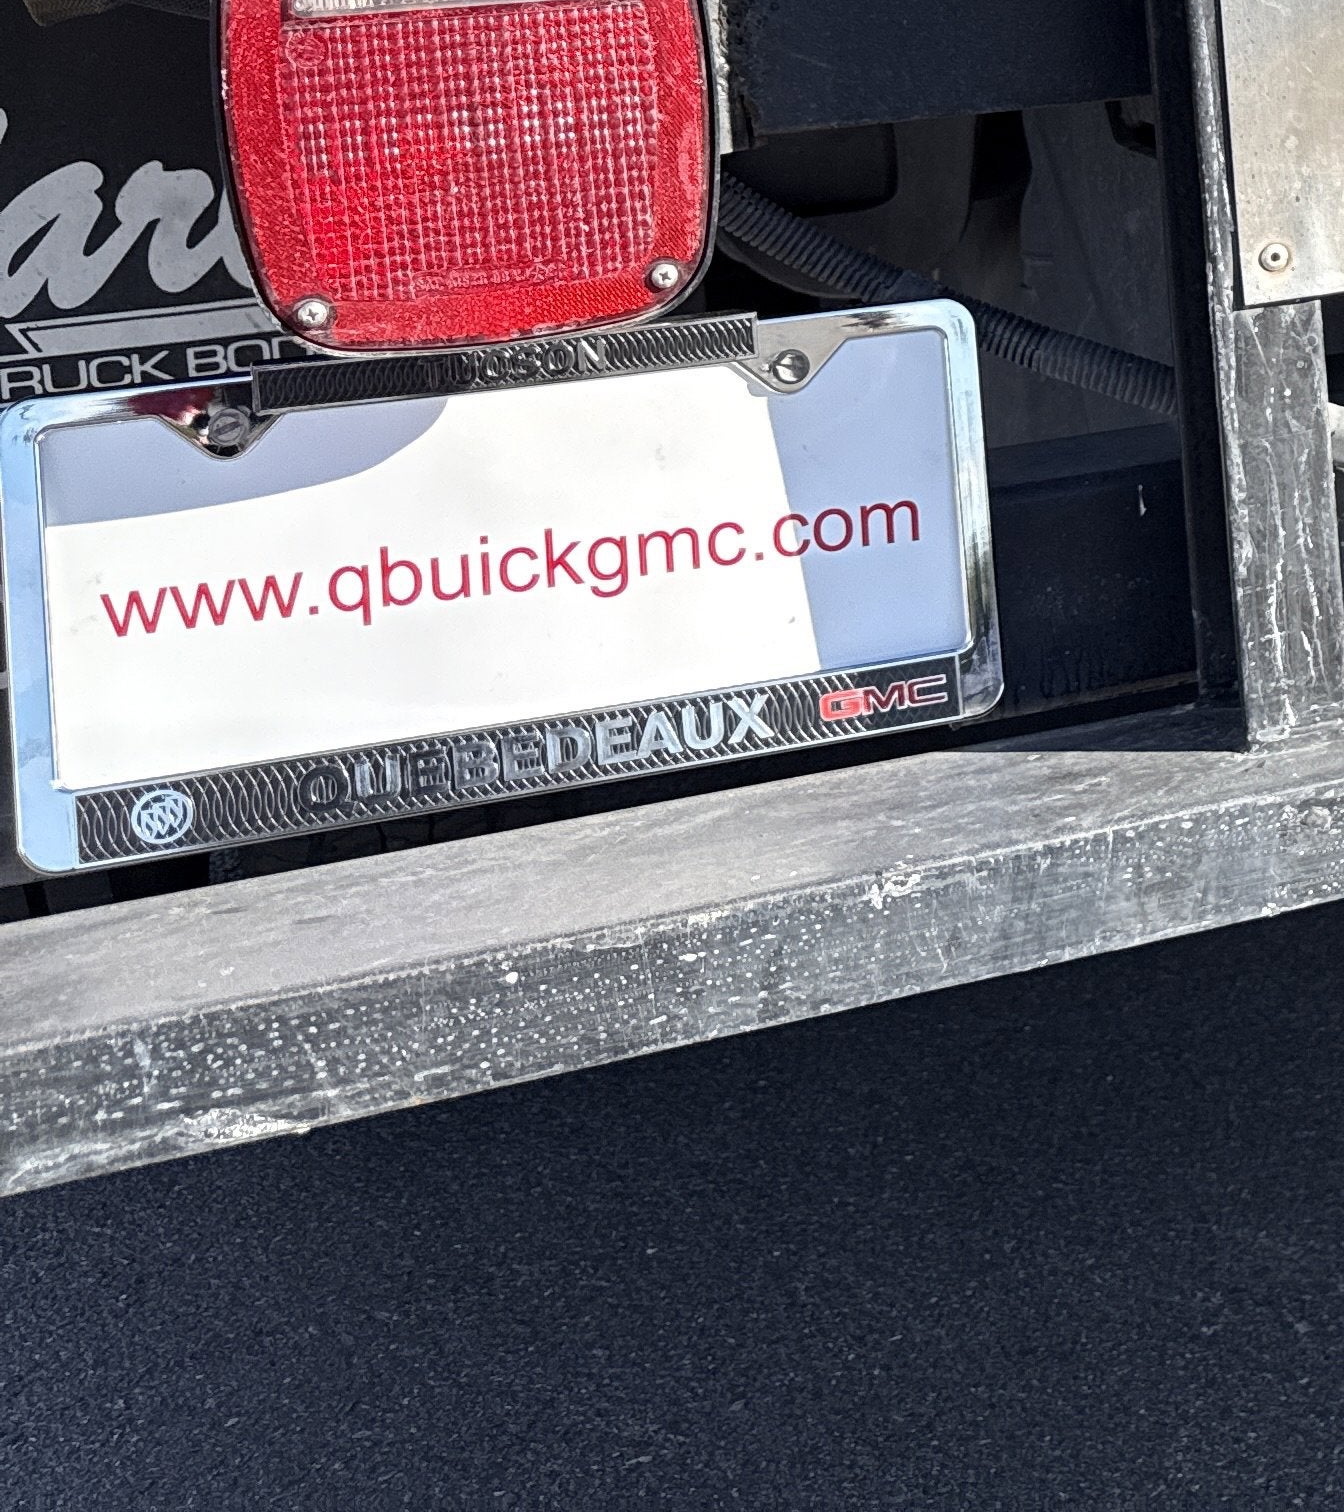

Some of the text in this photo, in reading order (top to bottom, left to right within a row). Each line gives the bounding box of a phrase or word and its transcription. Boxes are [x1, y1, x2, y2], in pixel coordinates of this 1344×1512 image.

[0, 350, 175, 400] RUCK
[419, 335, 606, 390] TUCSON
[100, 497, 922, 637] www.qbuickgmc.com
[297, 674, 948, 813] QUEBEDEAUX GMC
